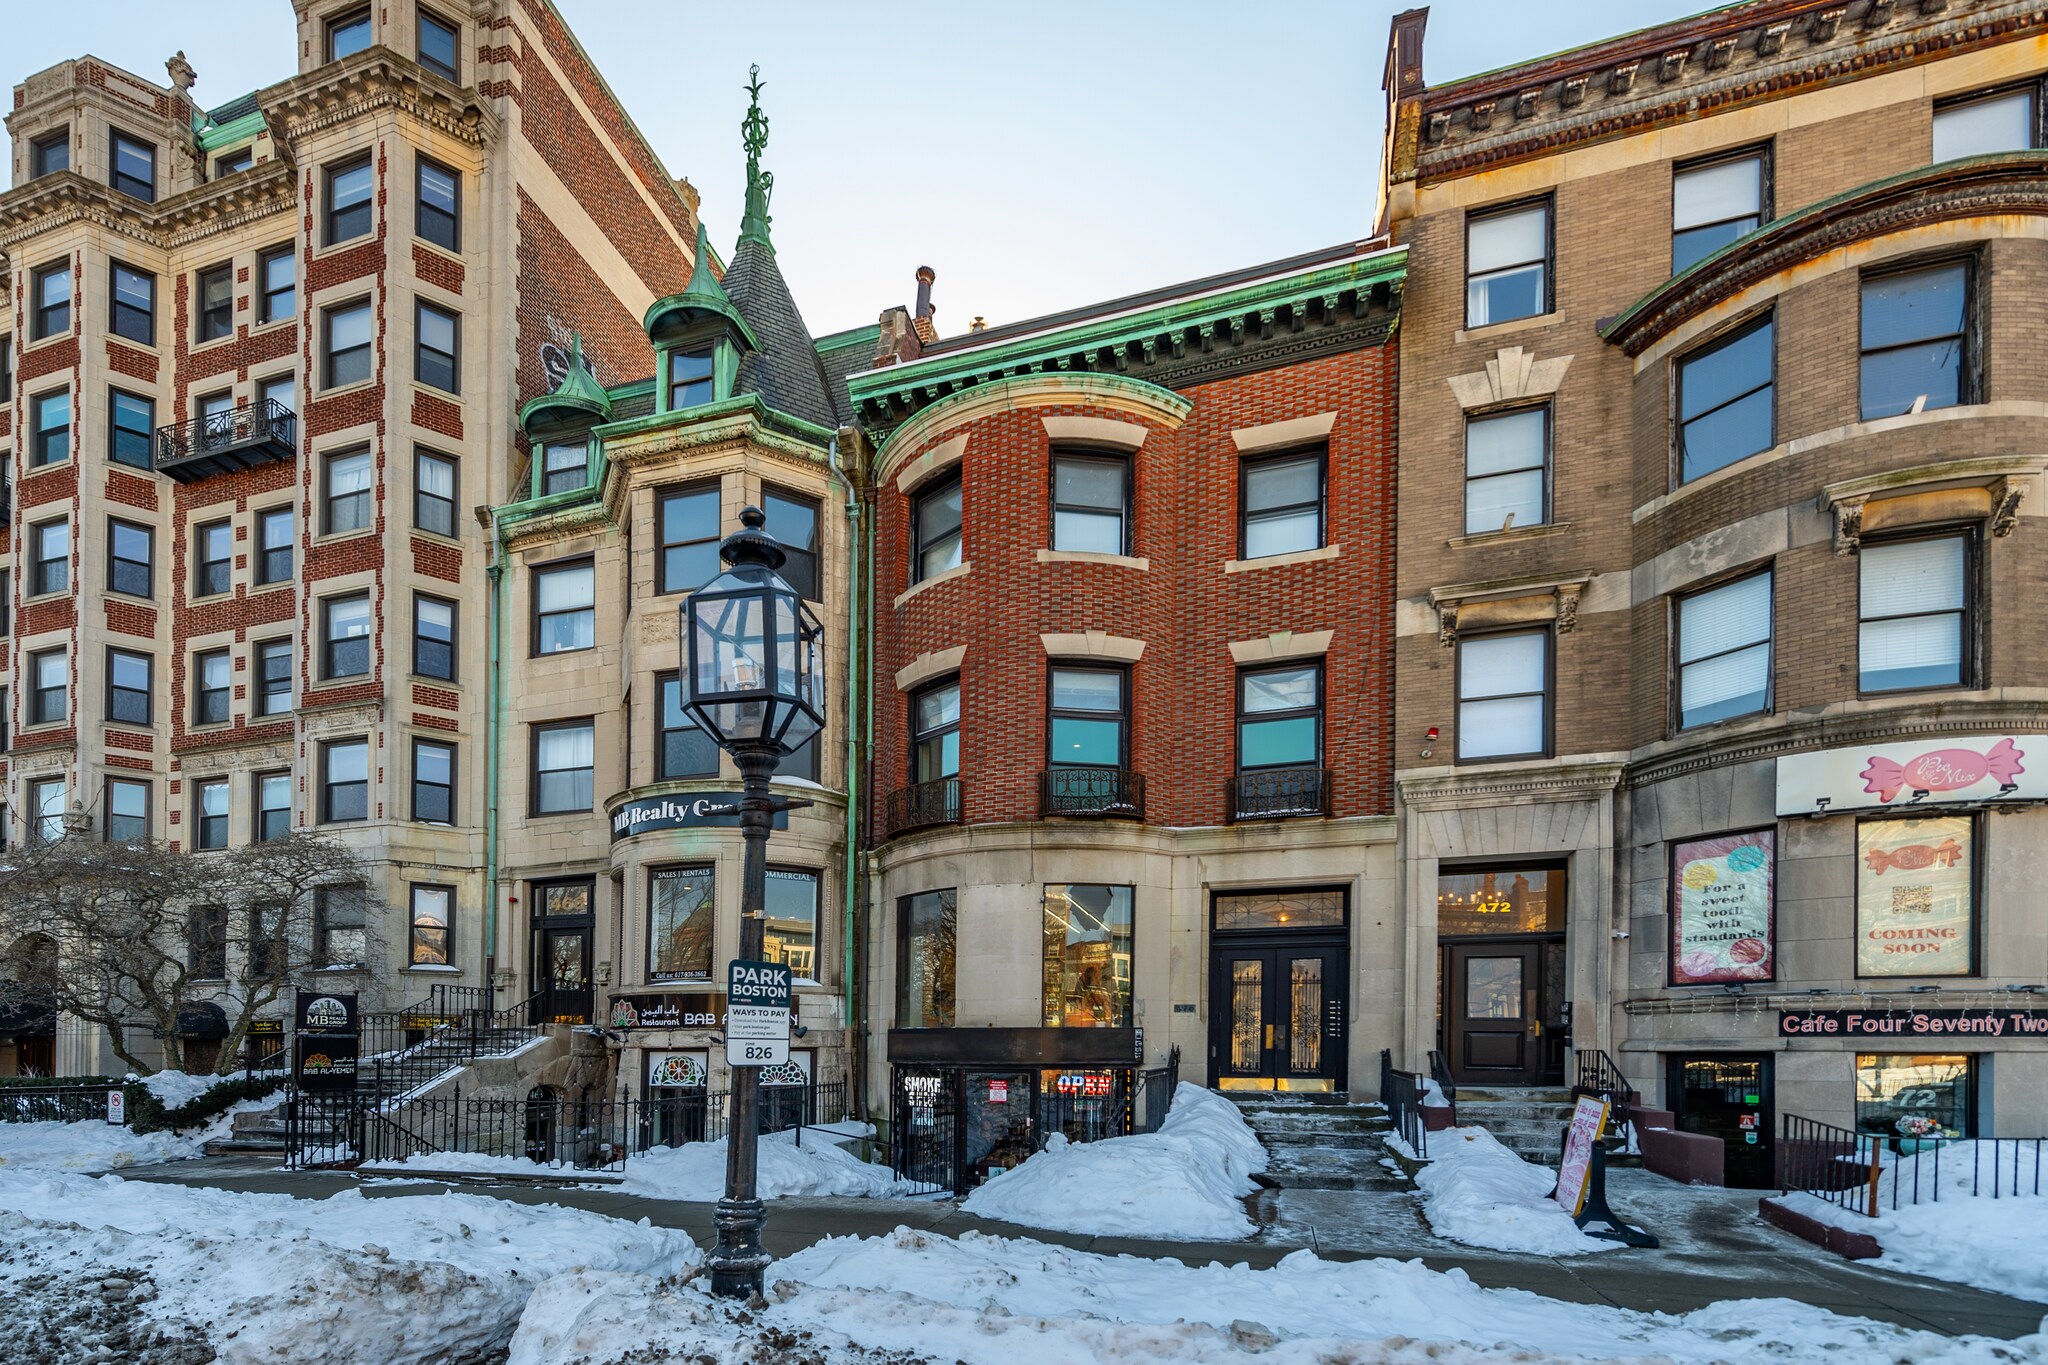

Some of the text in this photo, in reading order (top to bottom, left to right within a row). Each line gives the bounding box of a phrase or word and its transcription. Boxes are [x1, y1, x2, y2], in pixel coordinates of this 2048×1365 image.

[1917, 756, 1951, 775] Pic
[1930, 768, 1976, 786] Mix
[614, 812, 630, 833] MB
[631, 801, 690, 825] Realty
[658, 869, 710, 879] SALES RENTALS
[1703, 883, 1746, 894] For a
[1701, 894, 1745, 906] sweet
[1477, 902, 1511, 913] 472
[1702, 906, 1744, 918] tooth
[1706, 919, 1741, 929] with
[1685, 929, 1765, 943] standards
[1869, 928, 1957, 940] COMING
[1883, 942, 1941, 954] SOON
[732, 966, 787, 986] PARK
[732, 984, 787, 998] BOSTON
[641, 1004, 680, 1017] باب اليمن
[770, 1010, 786, 1018] PAY
[307, 1015, 328, 1025] MB
[684, 1013, 716, 1025] BAB
[1783, 1014, 2048, 1036] Cafe Four Seventy Two
[745, 1046, 773, 1059] 826
[303, 1067, 355, 1075] BAB AL-YEMEN
[905, 1076, 941, 1093] SMOKE
[1057, 1075, 1111, 1095] OPEN
